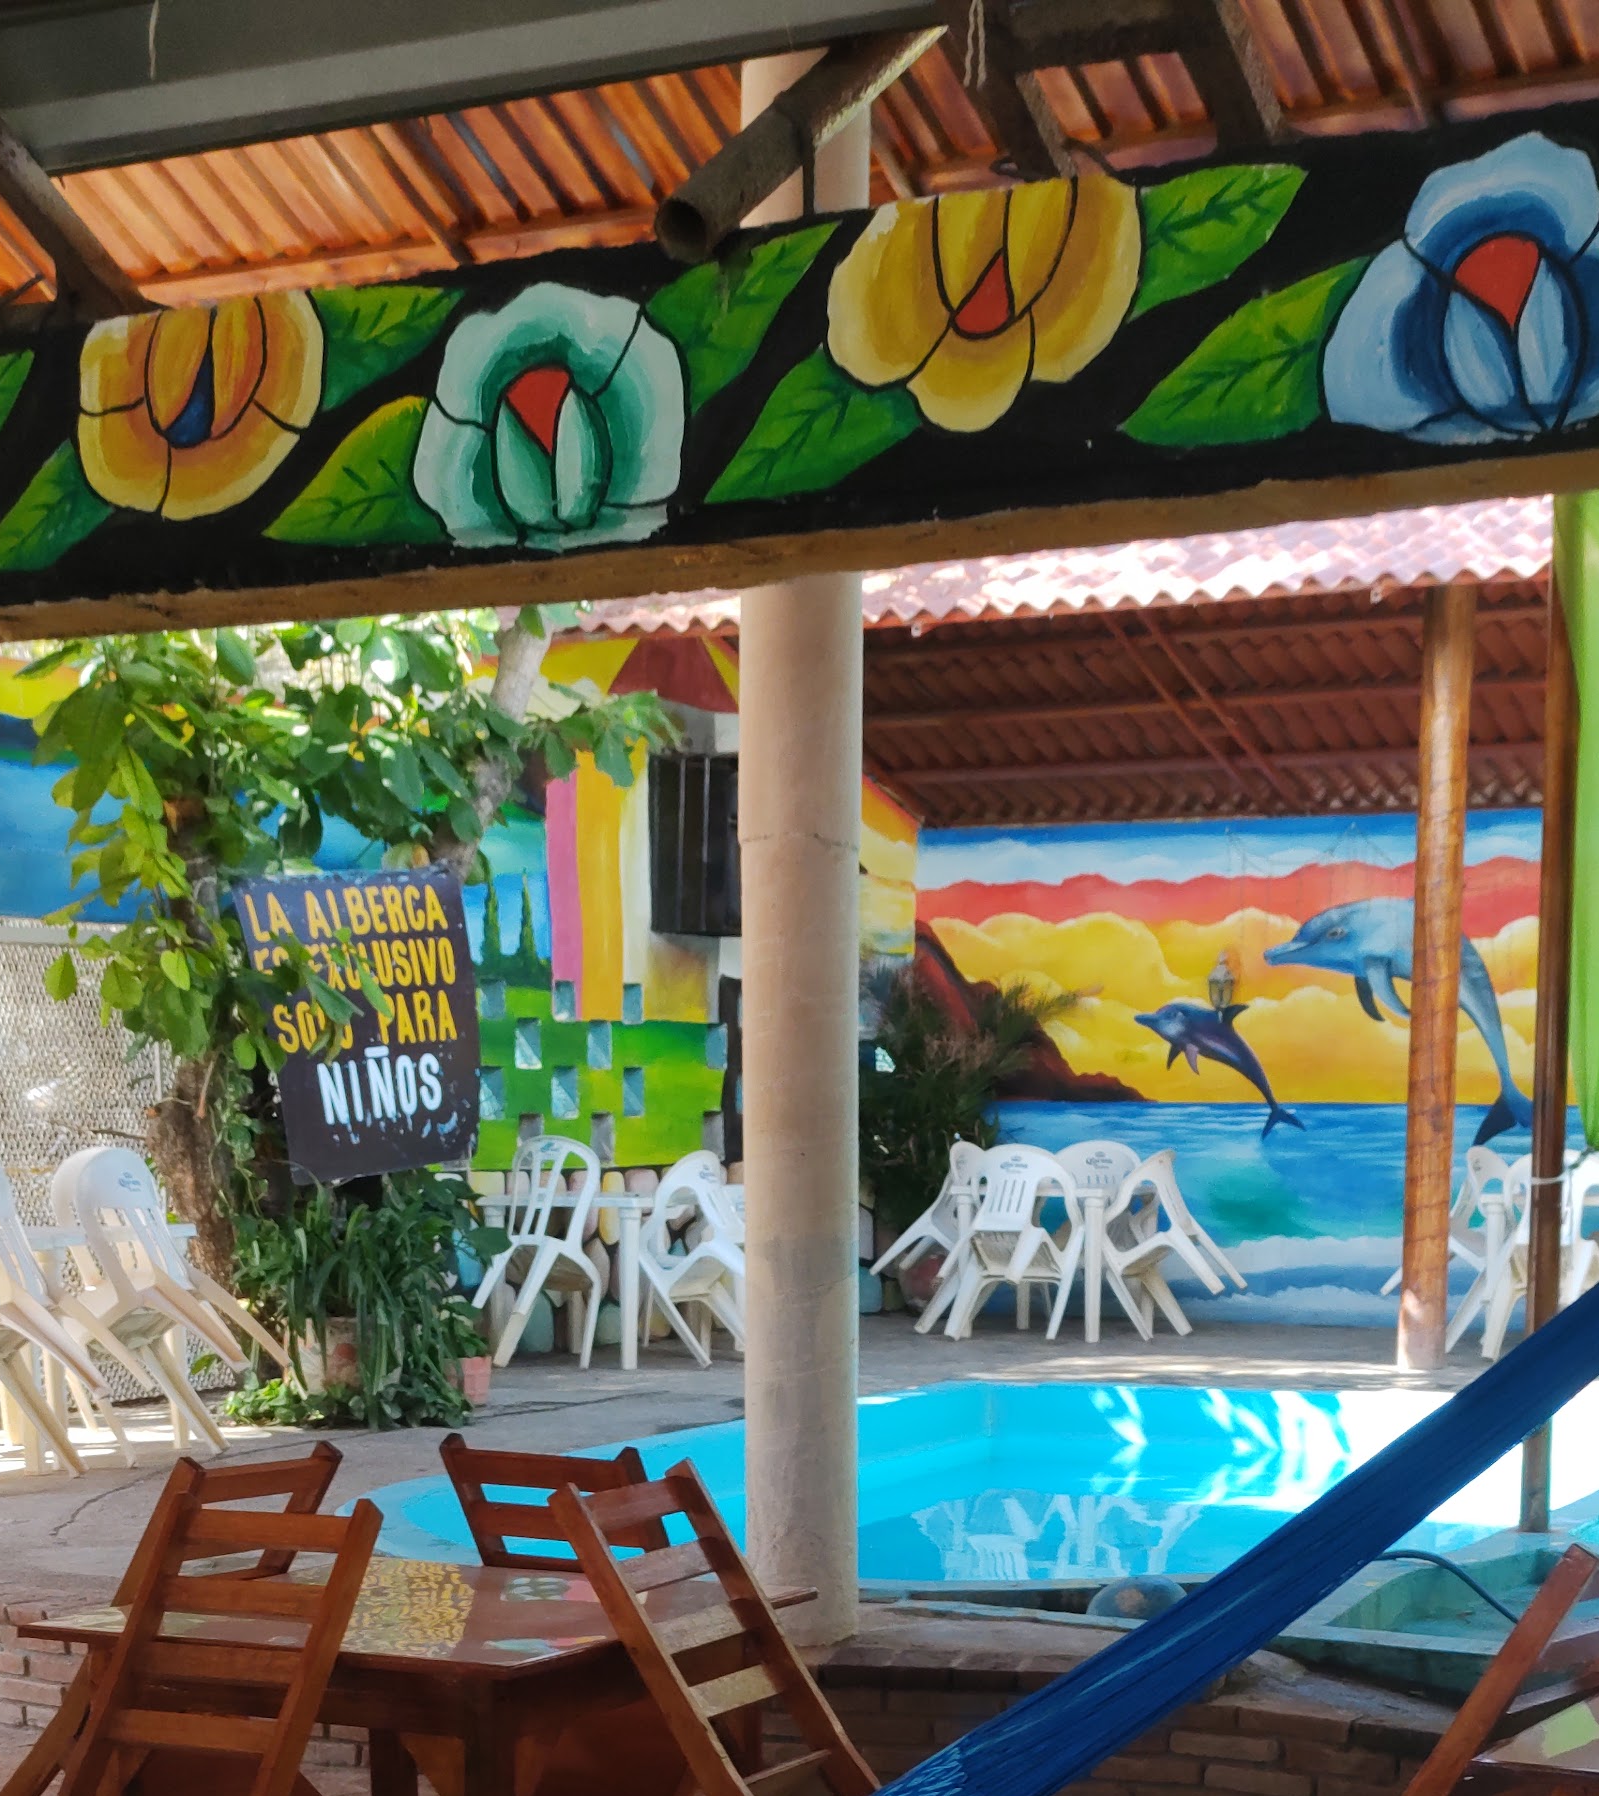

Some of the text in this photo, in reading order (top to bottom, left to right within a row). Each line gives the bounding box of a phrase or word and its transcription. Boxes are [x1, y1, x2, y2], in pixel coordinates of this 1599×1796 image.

[244, 883, 449, 943] LA ALBERCA
[376, 989, 458, 1045] PARA
[316, 1045, 444, 1126] NIÑOS
